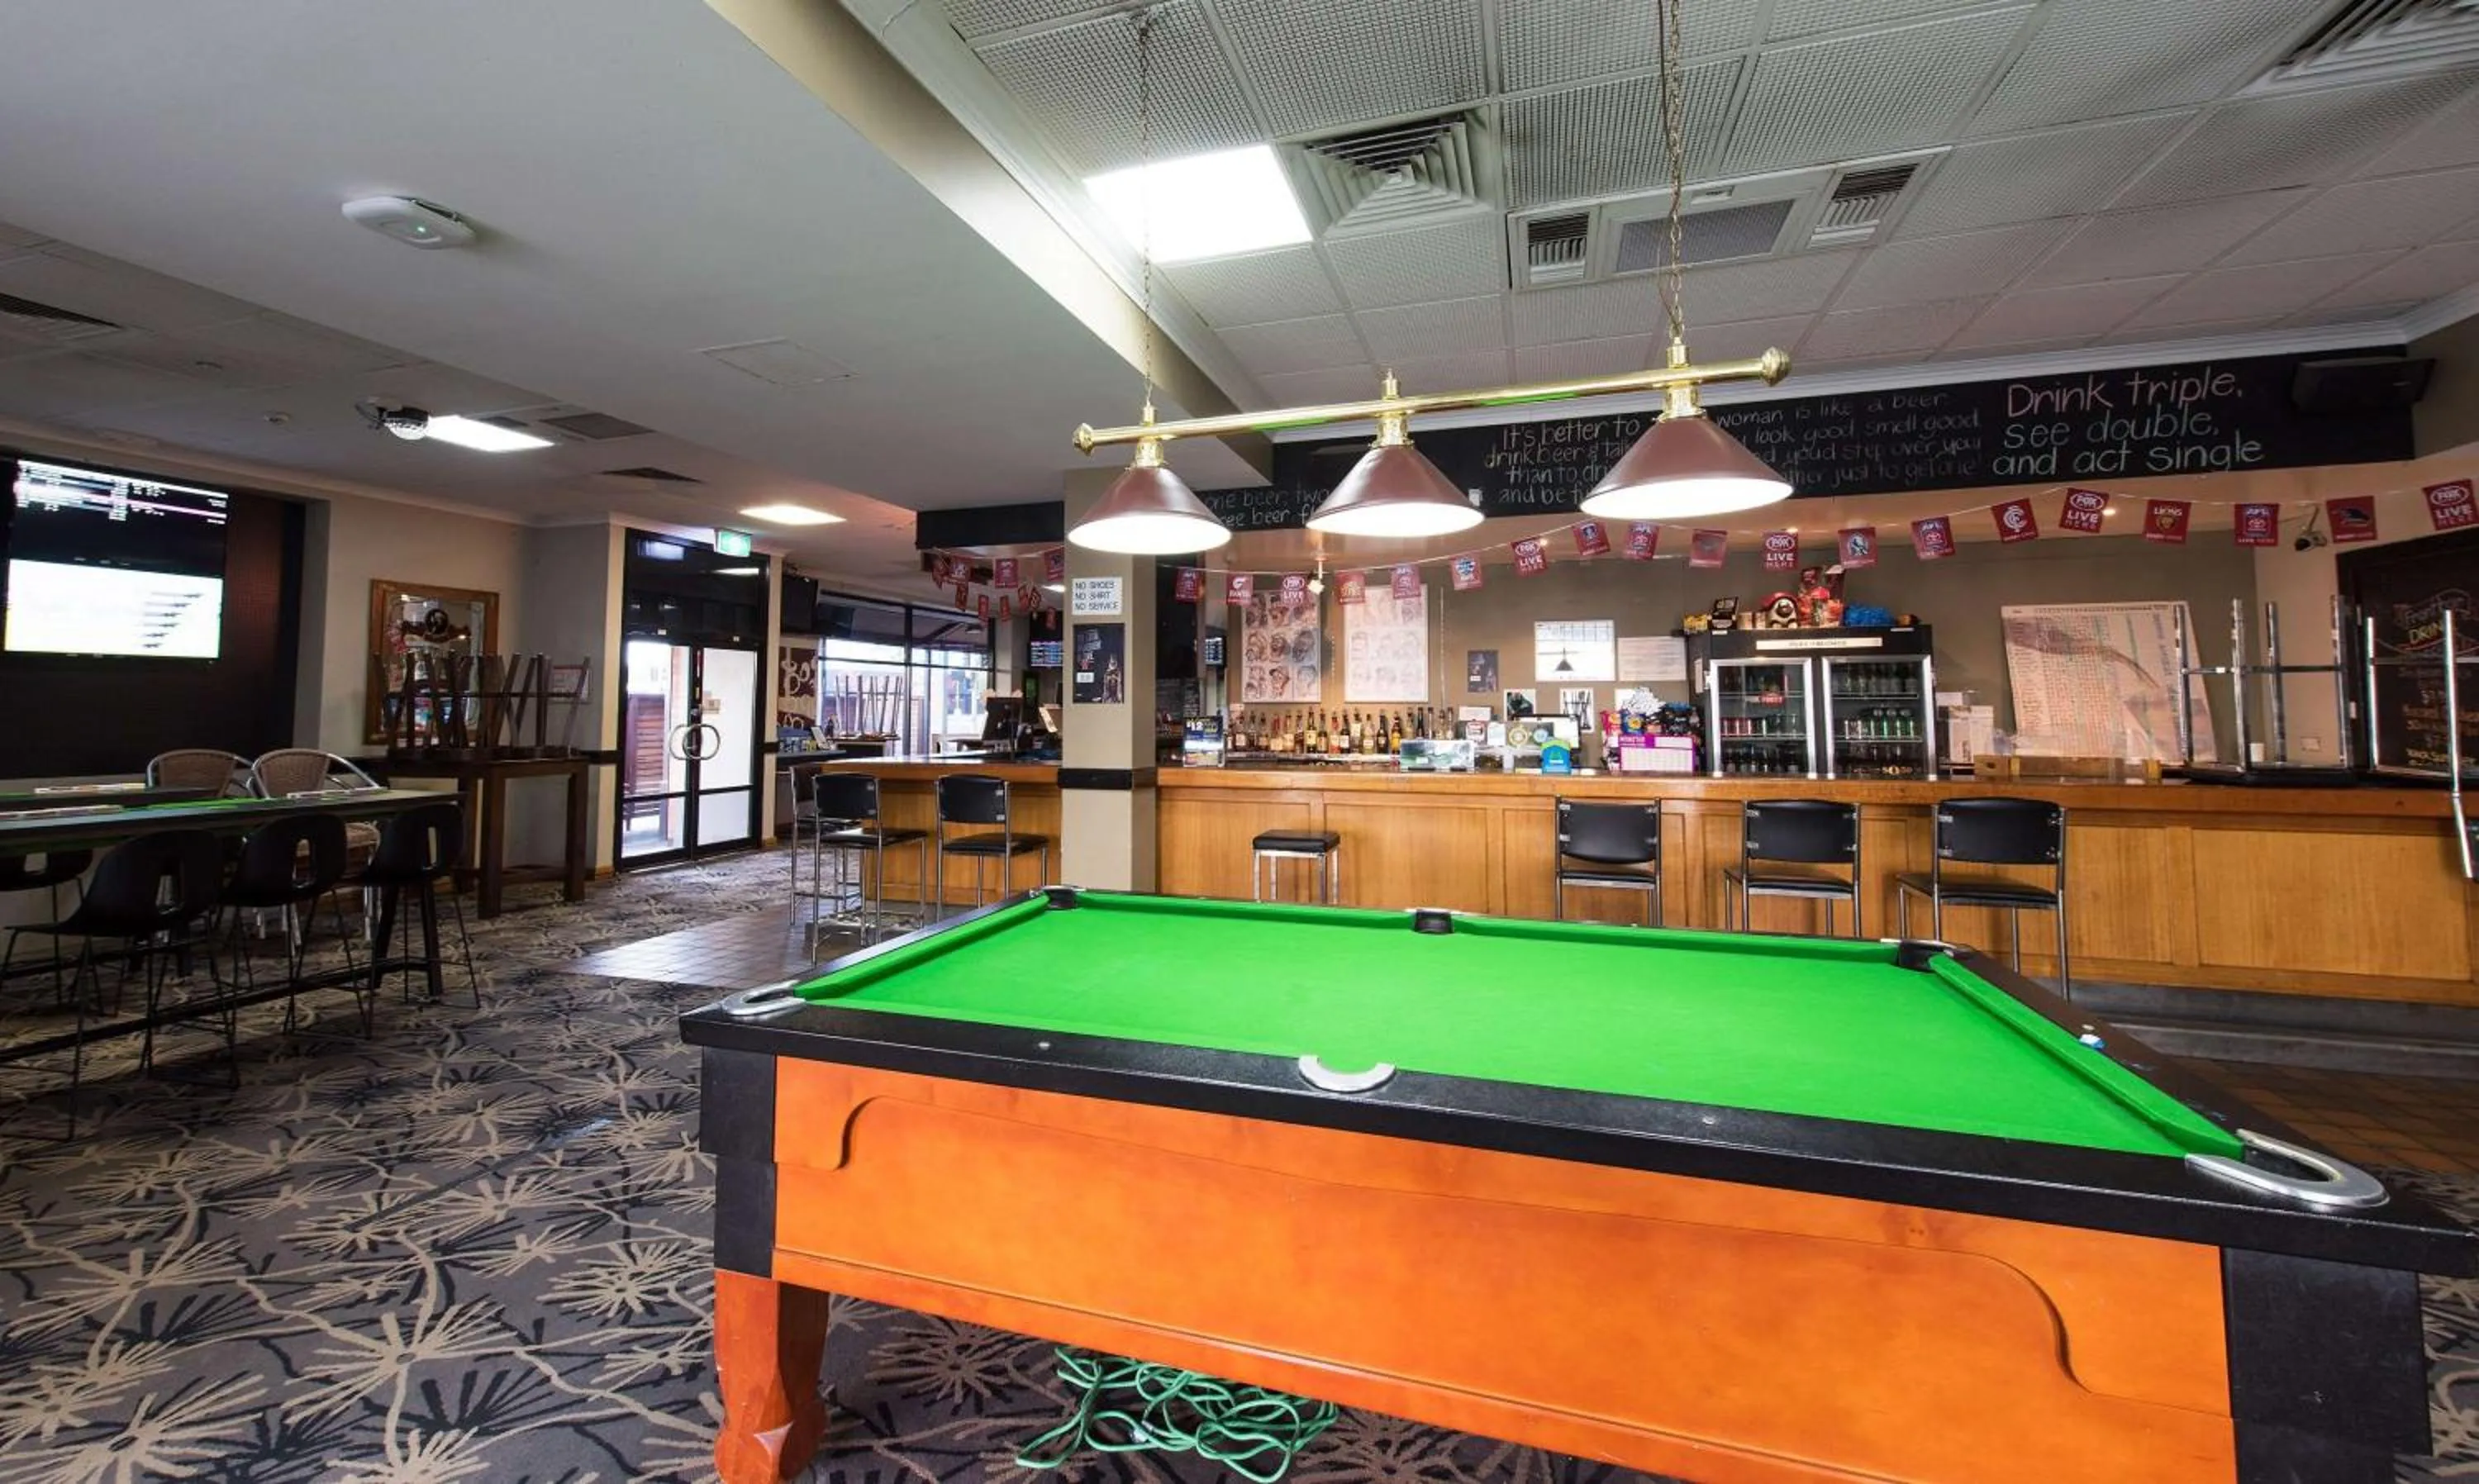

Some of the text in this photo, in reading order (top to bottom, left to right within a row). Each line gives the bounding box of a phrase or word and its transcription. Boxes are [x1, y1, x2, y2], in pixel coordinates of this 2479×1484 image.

[2007, 374, 2113, 417] Drink
[1716, 408, 1783, 428] woman
[1796, 404, 1811, 419] is
[1820, 399, 1852, 418] like
[1502, 415, 1640, 449] It's better to
[1755, 427, 1796, 445] look
[1803, 418, 1854, 447] good
[2004, 421, 2071, 449] see
[1485, 444, 1535, 469] drink
[1535, 444, 1584, 464] beer
[1992, 430, 2264, 475] and act single
[1506, 464, 1553, 484] than
[1557, 465, 1577, 483] to
[1499, 483, 1535, 505] and
[1541, 485, 1568, 505] be
[1251, 507, 1291, 526] beer
[2067, 510, 2099, 524] LIVE
[2153, 507, 2183, 516] LIONS
[2435, 504, 2473, 519] LIVE
[1519, 554, 1543, 568] LIVE
[1767, 552, 1794, 562] LIVE
[1088, 581, 1115, 589] SHOES
[1075, 592, 1111, 601] NO SHIRT
